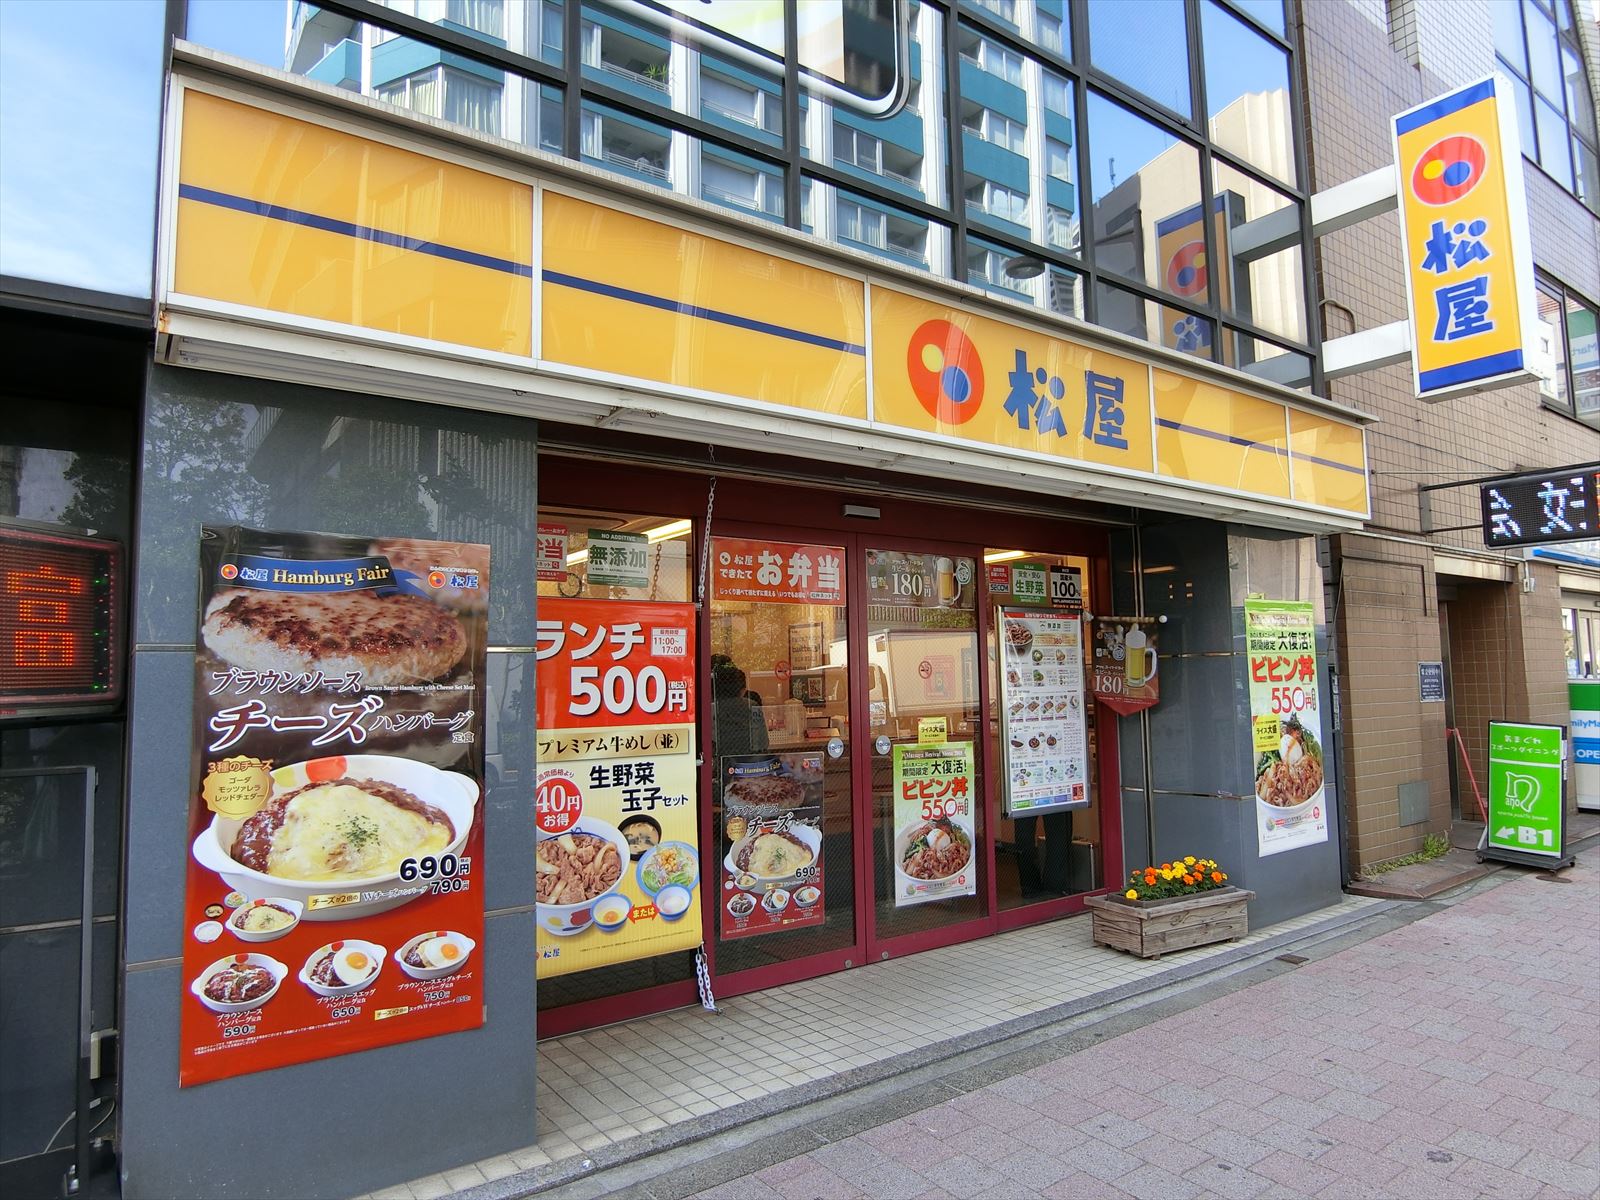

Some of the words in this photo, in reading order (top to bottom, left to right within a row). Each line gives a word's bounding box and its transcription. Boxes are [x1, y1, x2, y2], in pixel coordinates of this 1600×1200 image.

[1421, 219, 1493, 341] 松屋
[1003, 348, 1128, 451] 松屋
[589, 544, 647, 568] 無添加
[734, 554, 753, 566] 松屋
[240, 567, 269, 582] 松屋
[273, 569, 355, 586] Hamburg
[357, 565, 390, 582] Fair
[719, 568, 753, 580] できたて
[756, 550, 840, 590] お弁当
[450, 574, 479, 589] 松屋
[1016, 580, 1044, 594] 生野菜
[537, 621, 645, 661] ランチ
[1278, 632, 1312, 651] 大復活!
[662, 646, 683, 654] 17:00
[1251, 655, 1315, 683] ビビン丼
[209, 667, 361, 695] ブラウンソース
[209, 695, 383, 752] チーズ
[452, 731, 475, 743] 定食
[207, 759, 273, 773] 3種のチーズ
[902, 767, 928, 776] 期間限定
[931, 759, 967, 775] 大復活!
[229, 776, 252, 784] ゴーダ
[589, 762, 655, 789] 生野菜
[218, 785, 261, 793] モッツァレラ
[902, 776, 968, 800] ビビン丼
[215, 793, 265, 802] レッドチェダー
[621, 787, 689, 813] 玉子セット
[544, 813, 570, 827] お得
[748, 811, 794, 837] チーズ
[1517, 825, 1553, 847] B1
[632, 906, 656, 918] または
[543, 948, 561, 959] 松屋
[316, 988, 377, 1005] ブラウンソースエッグ
[217, 1008, 263, 1021] ブラウンソース
